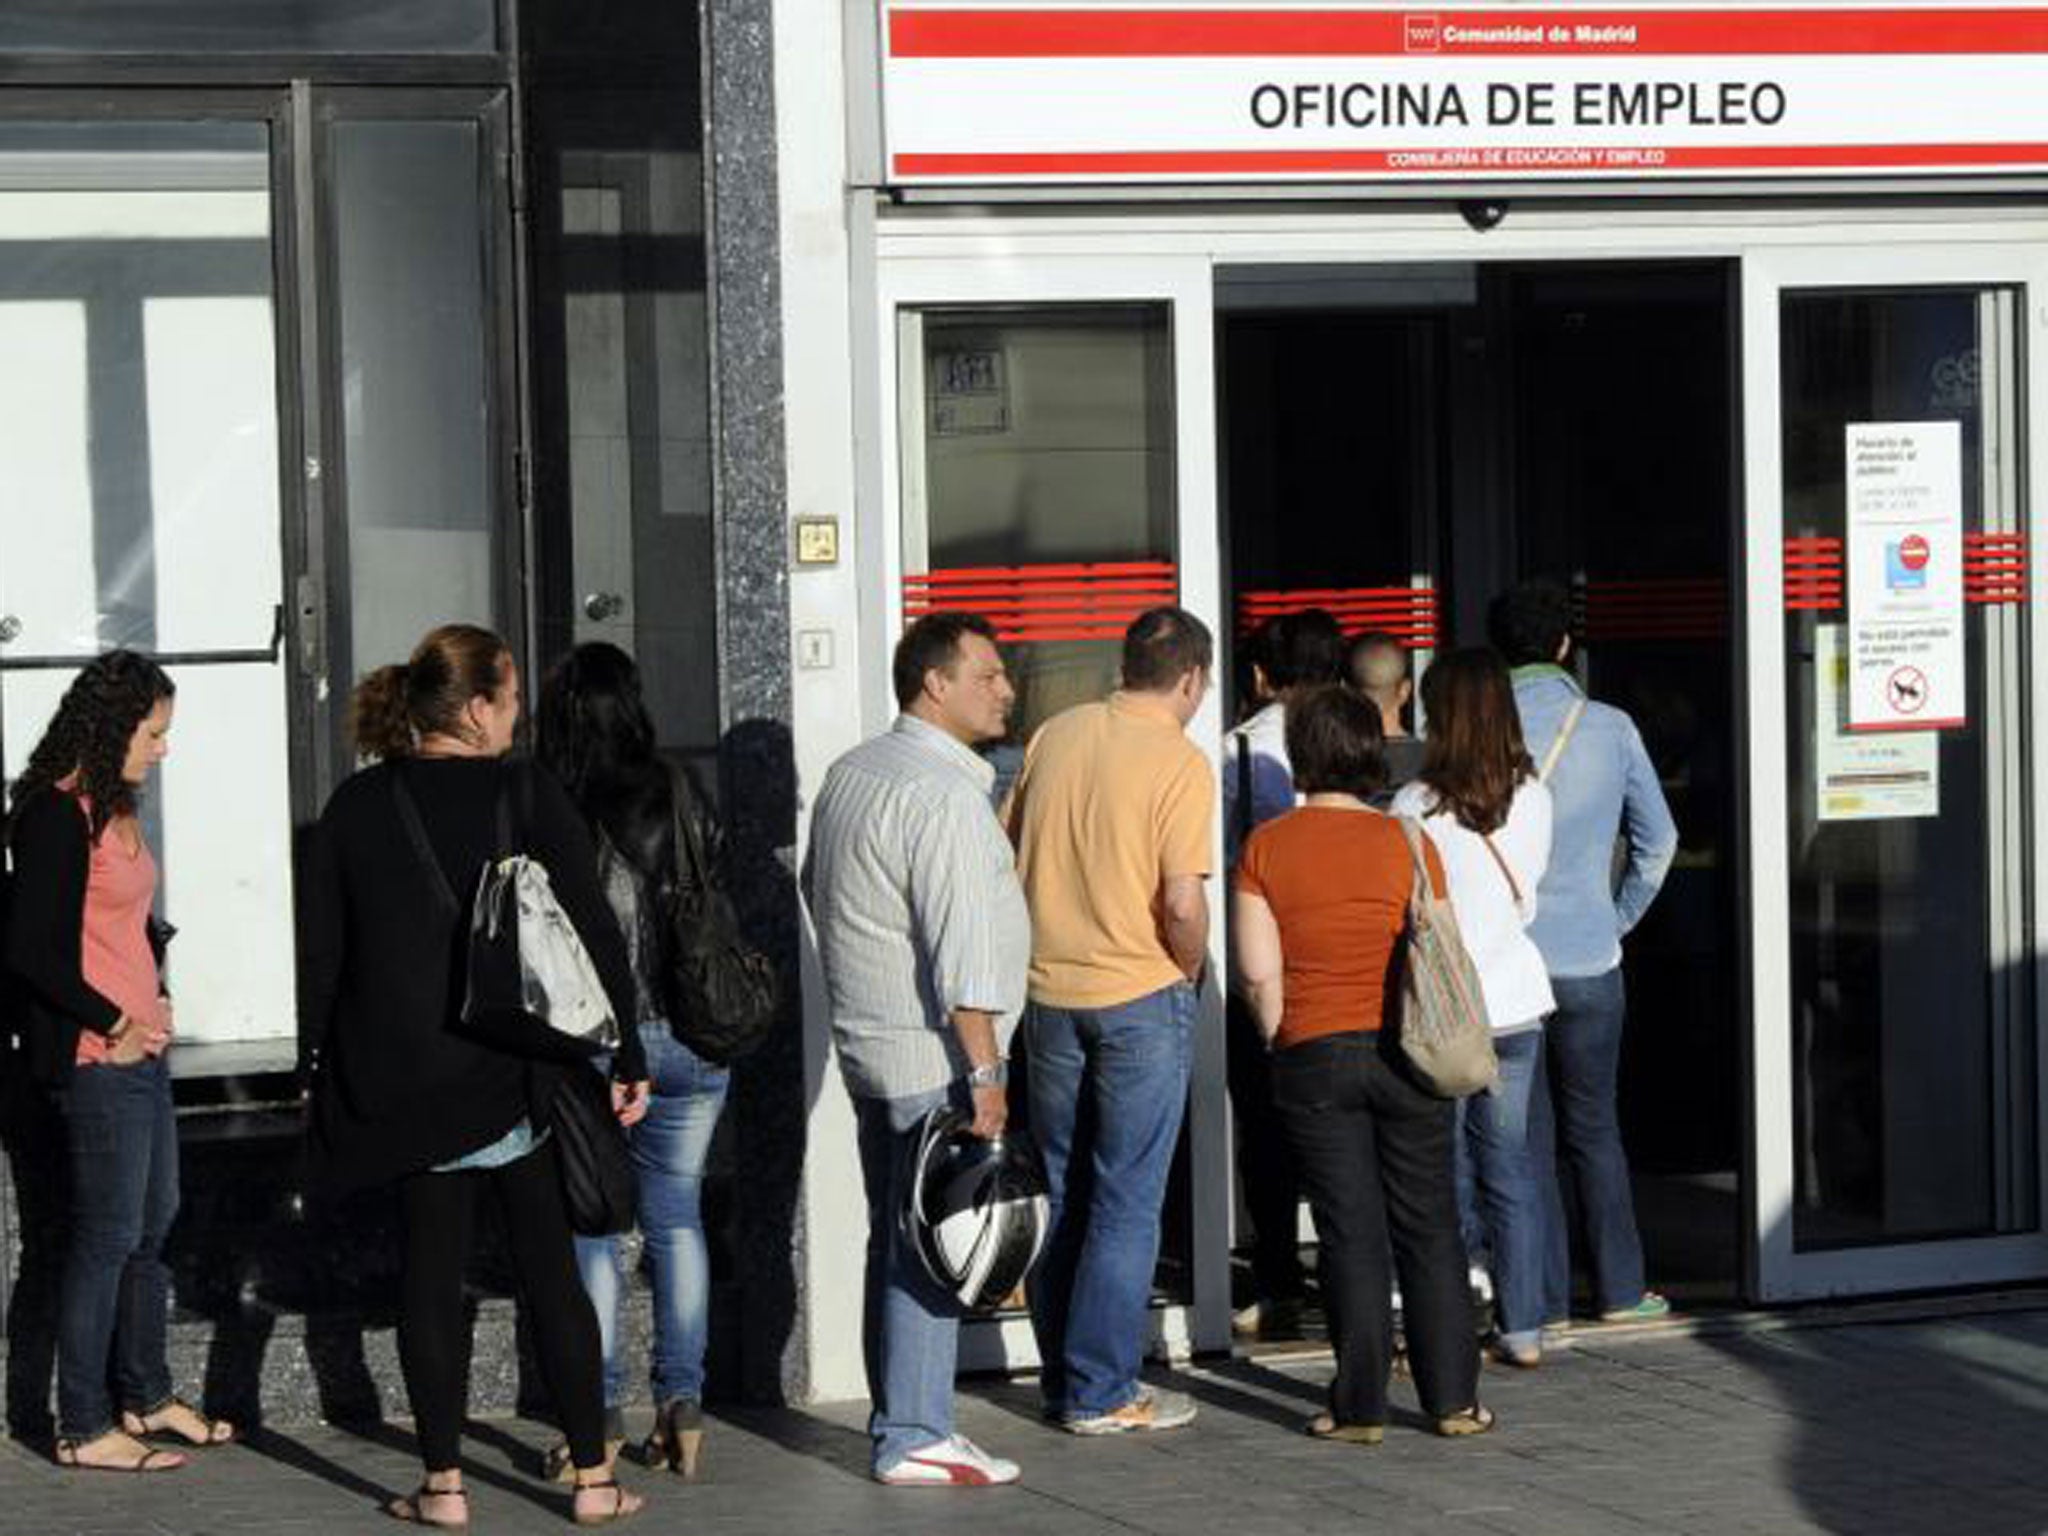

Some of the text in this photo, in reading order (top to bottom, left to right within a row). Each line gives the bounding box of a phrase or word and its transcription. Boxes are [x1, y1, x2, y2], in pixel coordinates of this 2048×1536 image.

[1443, 24, 1638, 44] Comunidad de Madrid
[1250, 82, 1786, 129] OFICINA DE EMPLEO
[1386, 149, 1666, 168] CONSEJERÍA DE EDUCACIÓN Y EMPLEO
